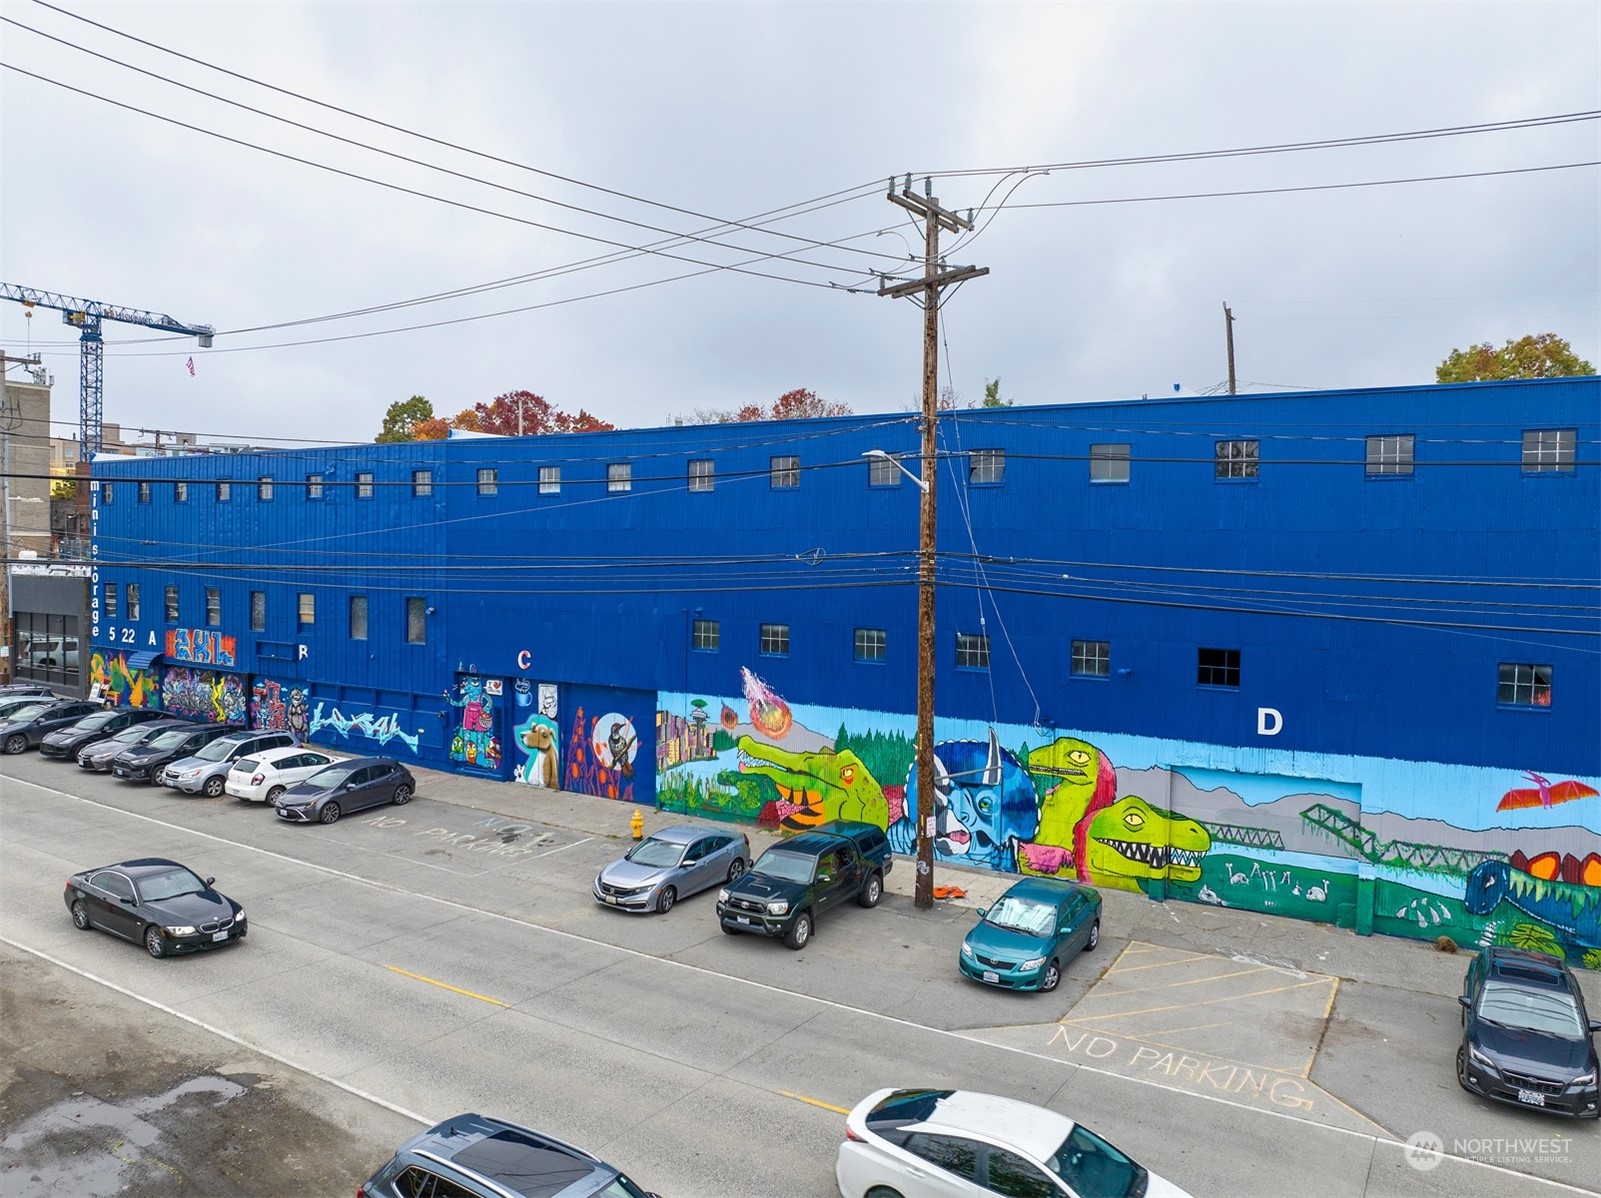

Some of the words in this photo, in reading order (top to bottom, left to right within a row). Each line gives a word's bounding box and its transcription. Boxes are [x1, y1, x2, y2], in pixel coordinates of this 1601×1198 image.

[90, 480, 100, 537] mini
[109, 626, 116, 641] 5
[121, 628, 136, 644] 22
[148, 631, 157, 646] A
[517, 650, 532, 670] C
[1257, 707, 1284, 736] D
[1047, 1024, 1118, 1059] NO
[1128, 1046, 1314, 1111] PARKING
